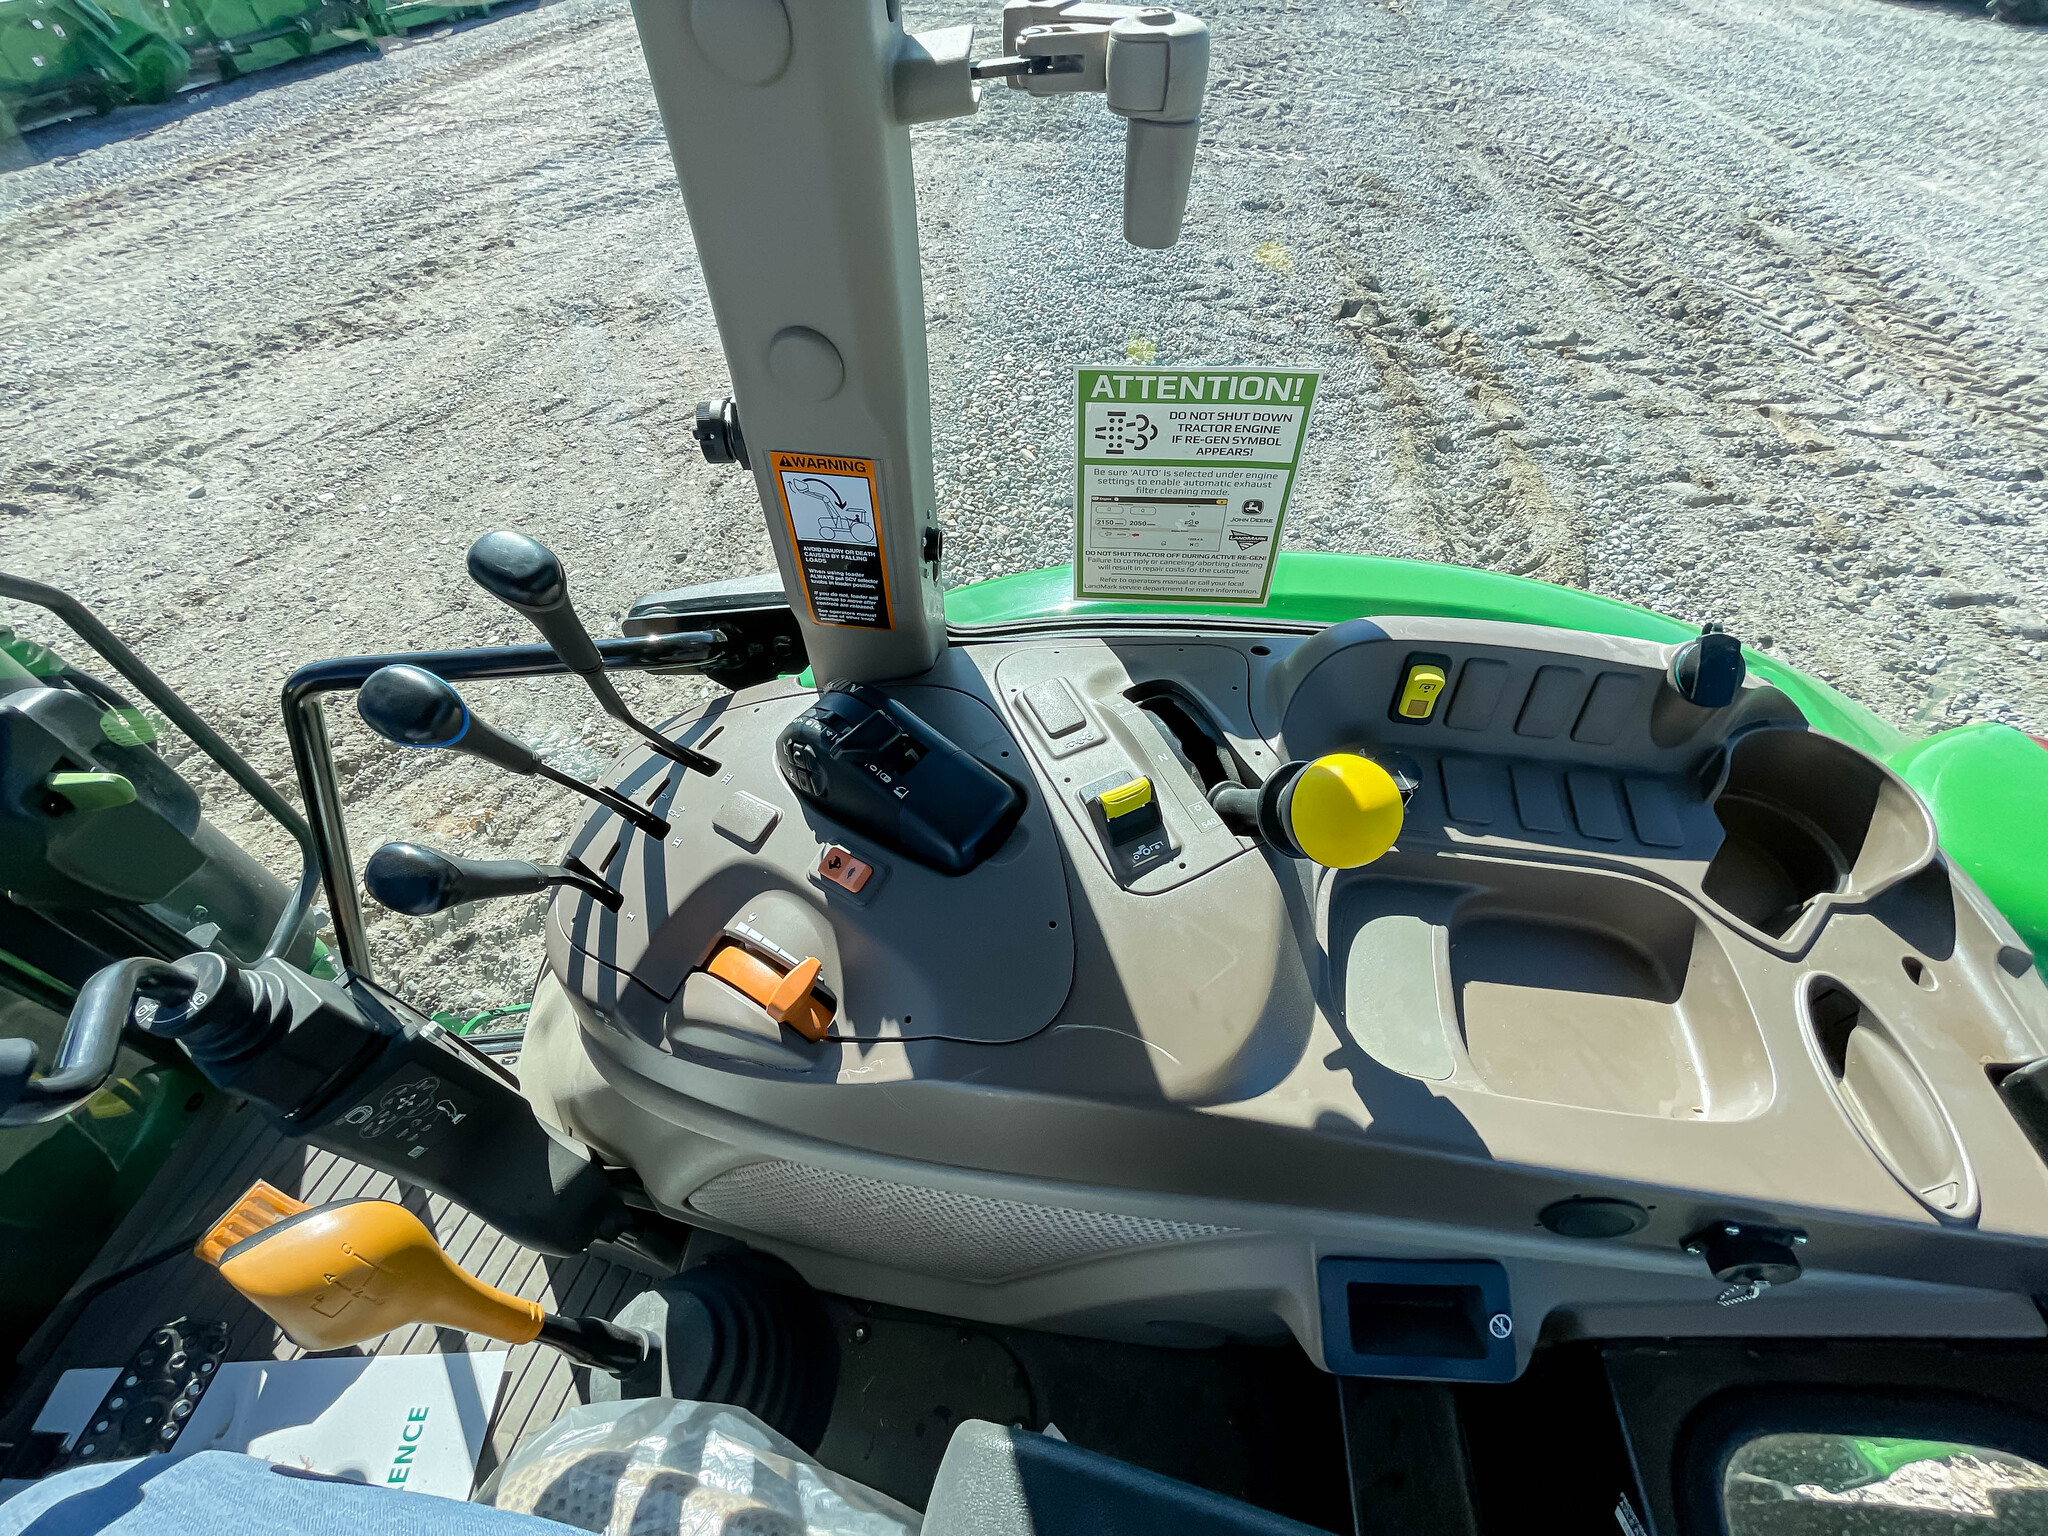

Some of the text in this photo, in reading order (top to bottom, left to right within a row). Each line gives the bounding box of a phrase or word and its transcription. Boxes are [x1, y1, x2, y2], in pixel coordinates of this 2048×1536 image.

[1091, 374, 1305, 401] ATTENTION!
[1169, 412, 1293, 423] DO NOT SHUT DOWN
[1178, 424, 1281, 435] TRACTOR ENGINE
[1172, 435, 1282, 446] IF RE-GEN SYMBOL
[1196, 447, 1254, 456] APPEARS!
[791, 456, 866, 473] WARNING
[1094, 468, 1106, 476] Be
[1131, 469, 1161, 477] 'AUTO'
[1173, 470, 1213, 478] selected
[1216, 471, 1244, 479] under
[1246, 472, 1278, 480] engine
[1098, 478, 1135, 486] settings
[1183, 479, 1231, 487] automatic
[1234, 480, 1272, 488] exhaust
[1160, 487, 1200, 496] cleaning
[1201, 488, 1230, 496] mode.
[1160, 560, 1229, 568] canceling/aborting
[1158, 753, 1169, 762] N
[1201, 817, 1218, 829] 540
[387, 1407, 430, 1491] ENCE
